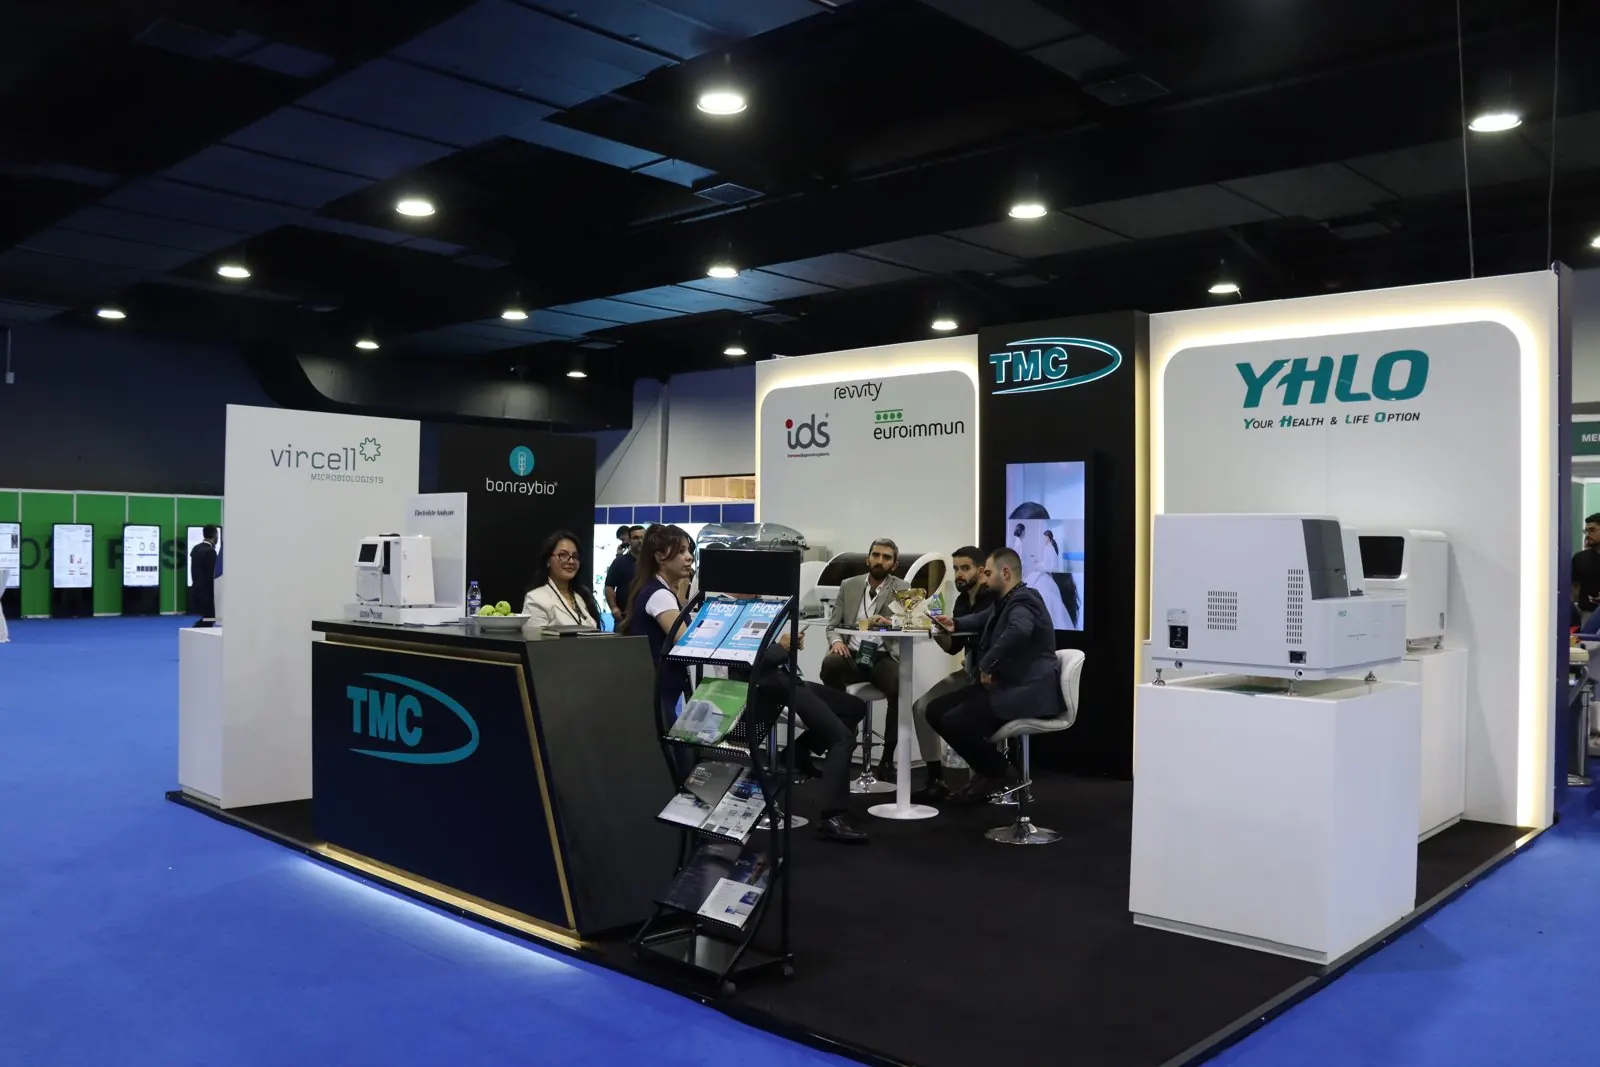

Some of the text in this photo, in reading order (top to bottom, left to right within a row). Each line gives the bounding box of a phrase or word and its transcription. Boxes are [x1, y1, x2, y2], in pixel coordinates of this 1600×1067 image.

[989, 347, 1068, 384] TMC
[1236, 350, 1429, 408] YHLO
[834, 382, 883, 401] revvity
[873, 420, 964, 440] euroimmun
[1279, 415, 1324, 427] HEALTH
[1329, 416, 1337, 425] &
[1344, 414, 1369, 425] LIFE
[785, 413, 830, 450] ids
[1581, 433, 1600, 443] ME
[270, 443, 356, 471] vircell
[310, 473, 384, 484] MICROBIOLOGISTS
[486, 477, 556, 496] bonraybio
[347, 685, 423, 747] TMC
